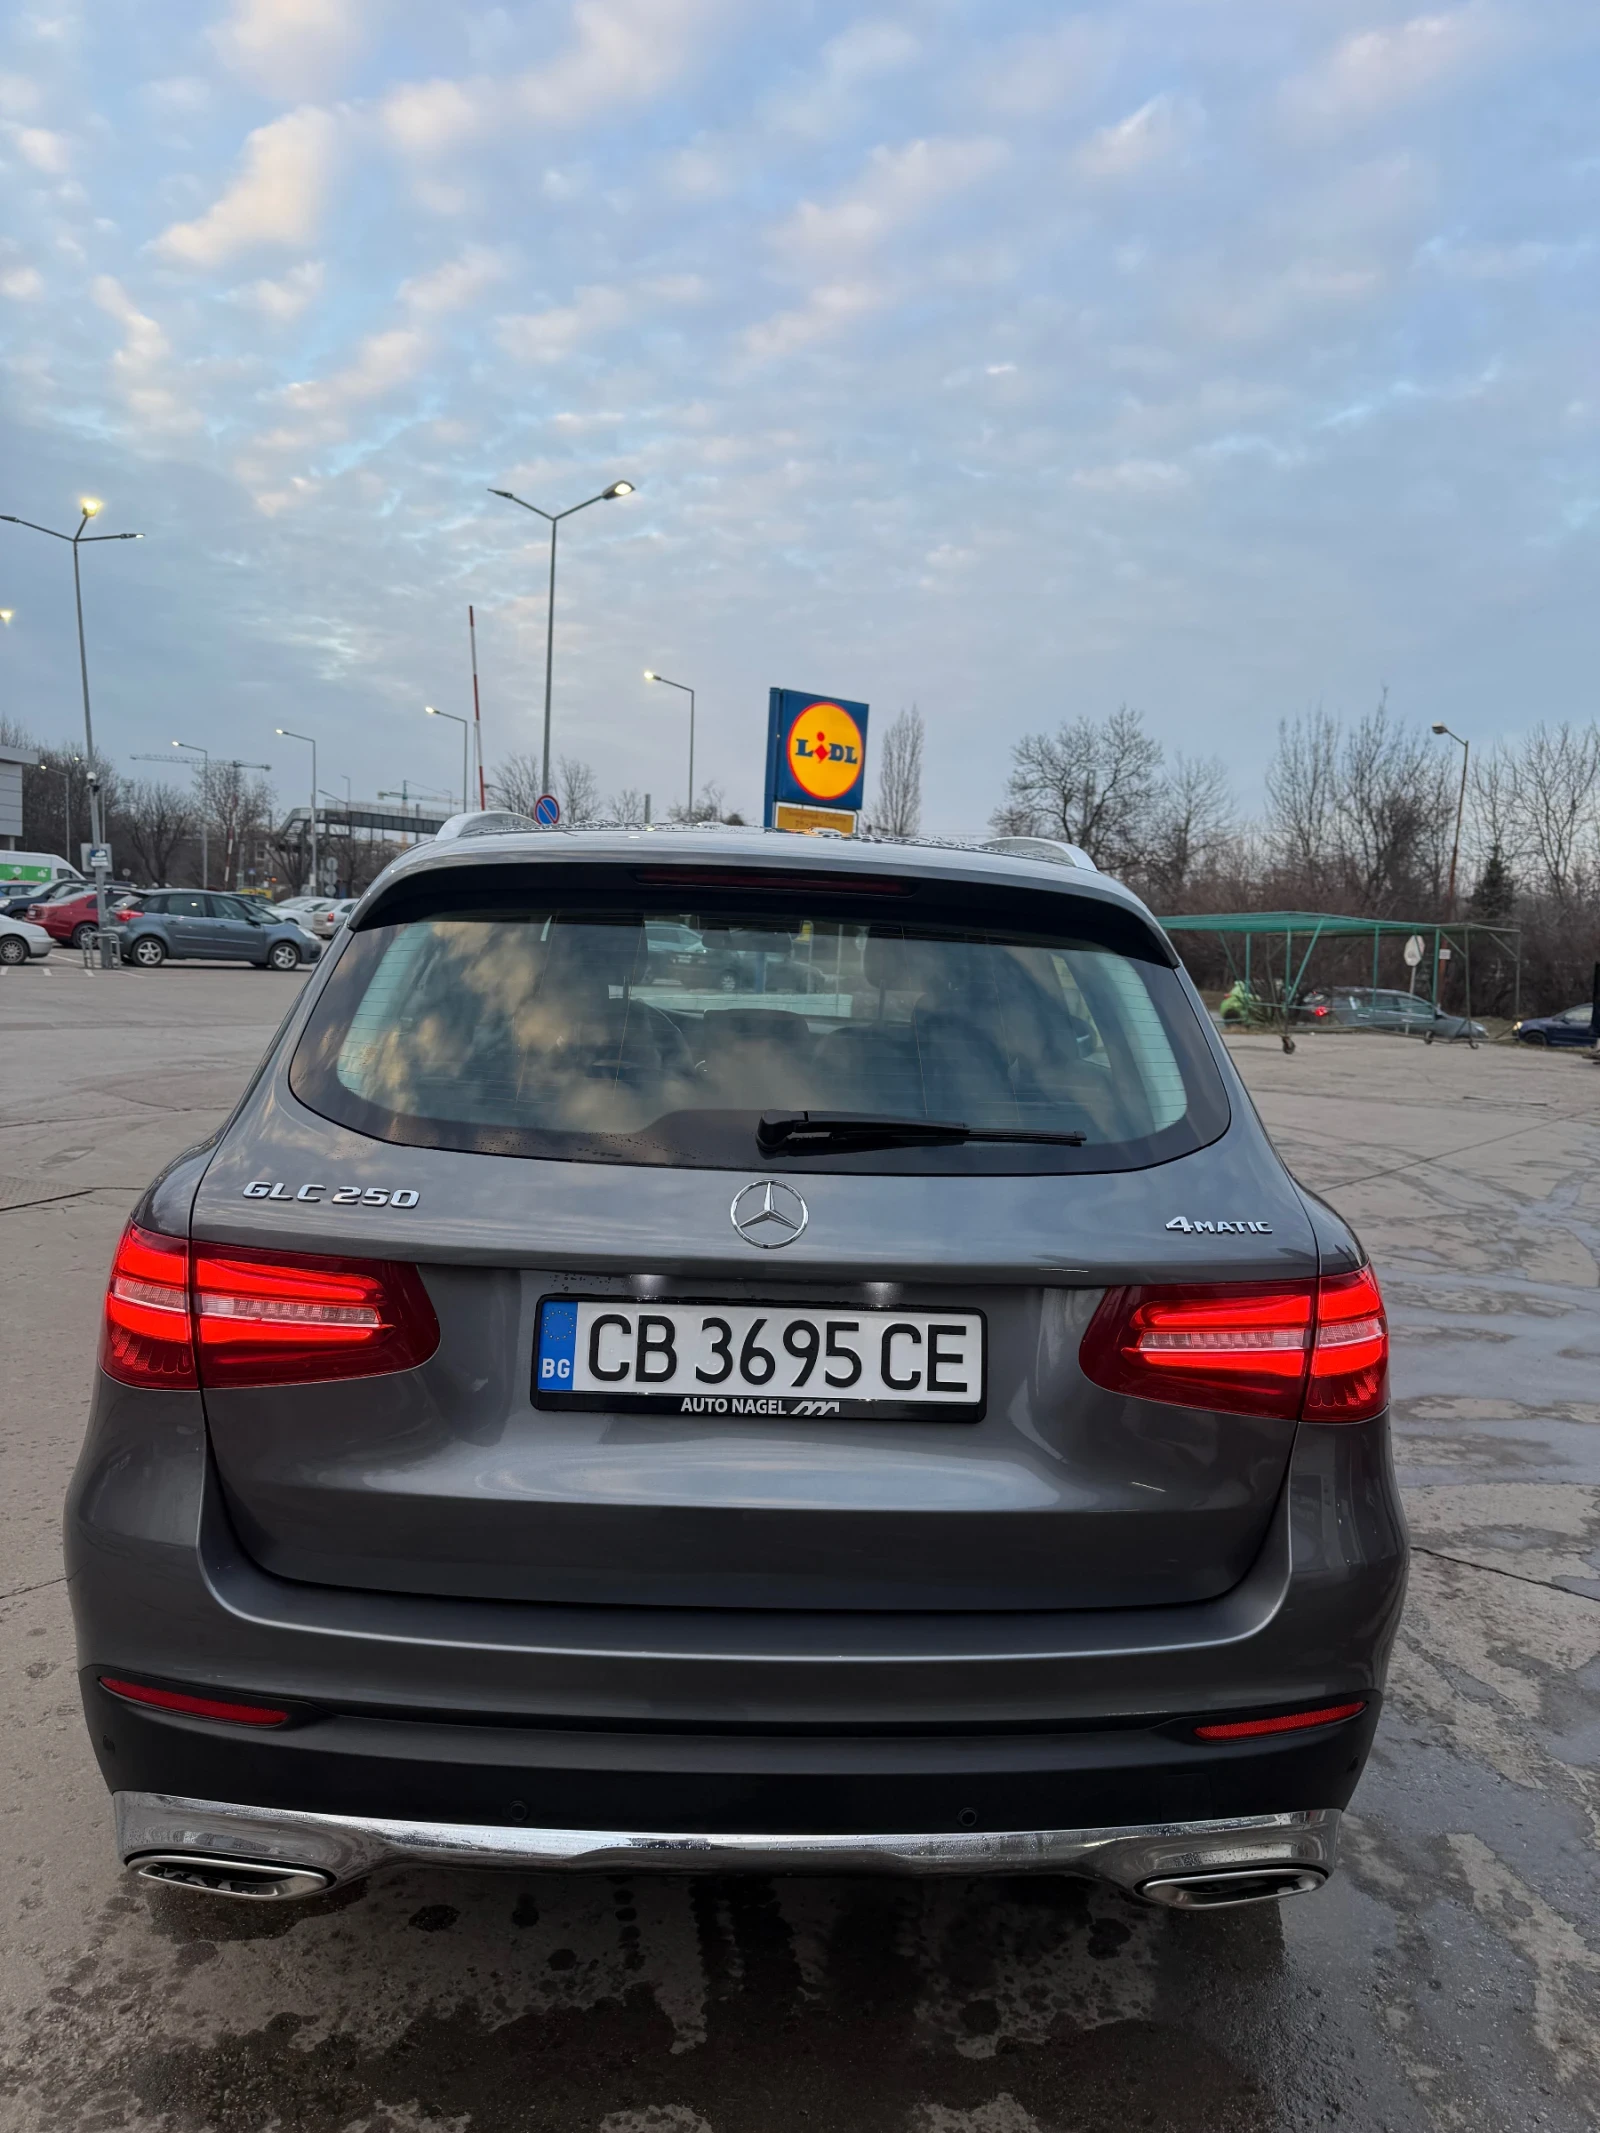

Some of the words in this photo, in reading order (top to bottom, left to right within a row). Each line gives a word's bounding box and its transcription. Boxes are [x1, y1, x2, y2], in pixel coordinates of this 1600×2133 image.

[243, 1181, 327, 1203] GLC
[331, 1186, 421, 1209] 250
[1165, 1216, 1274, 1235] 4MATIC
[588, 1314, 677, 1384] CB
[695, 1317, 863, 1391] 3695
[880, 1323, 968, 1393] CE
[541, 1357, 571, 1380] BG
[680, 1397, 729, 1414] AUTO
[731, 1398, 788, 1416] NAGEL
